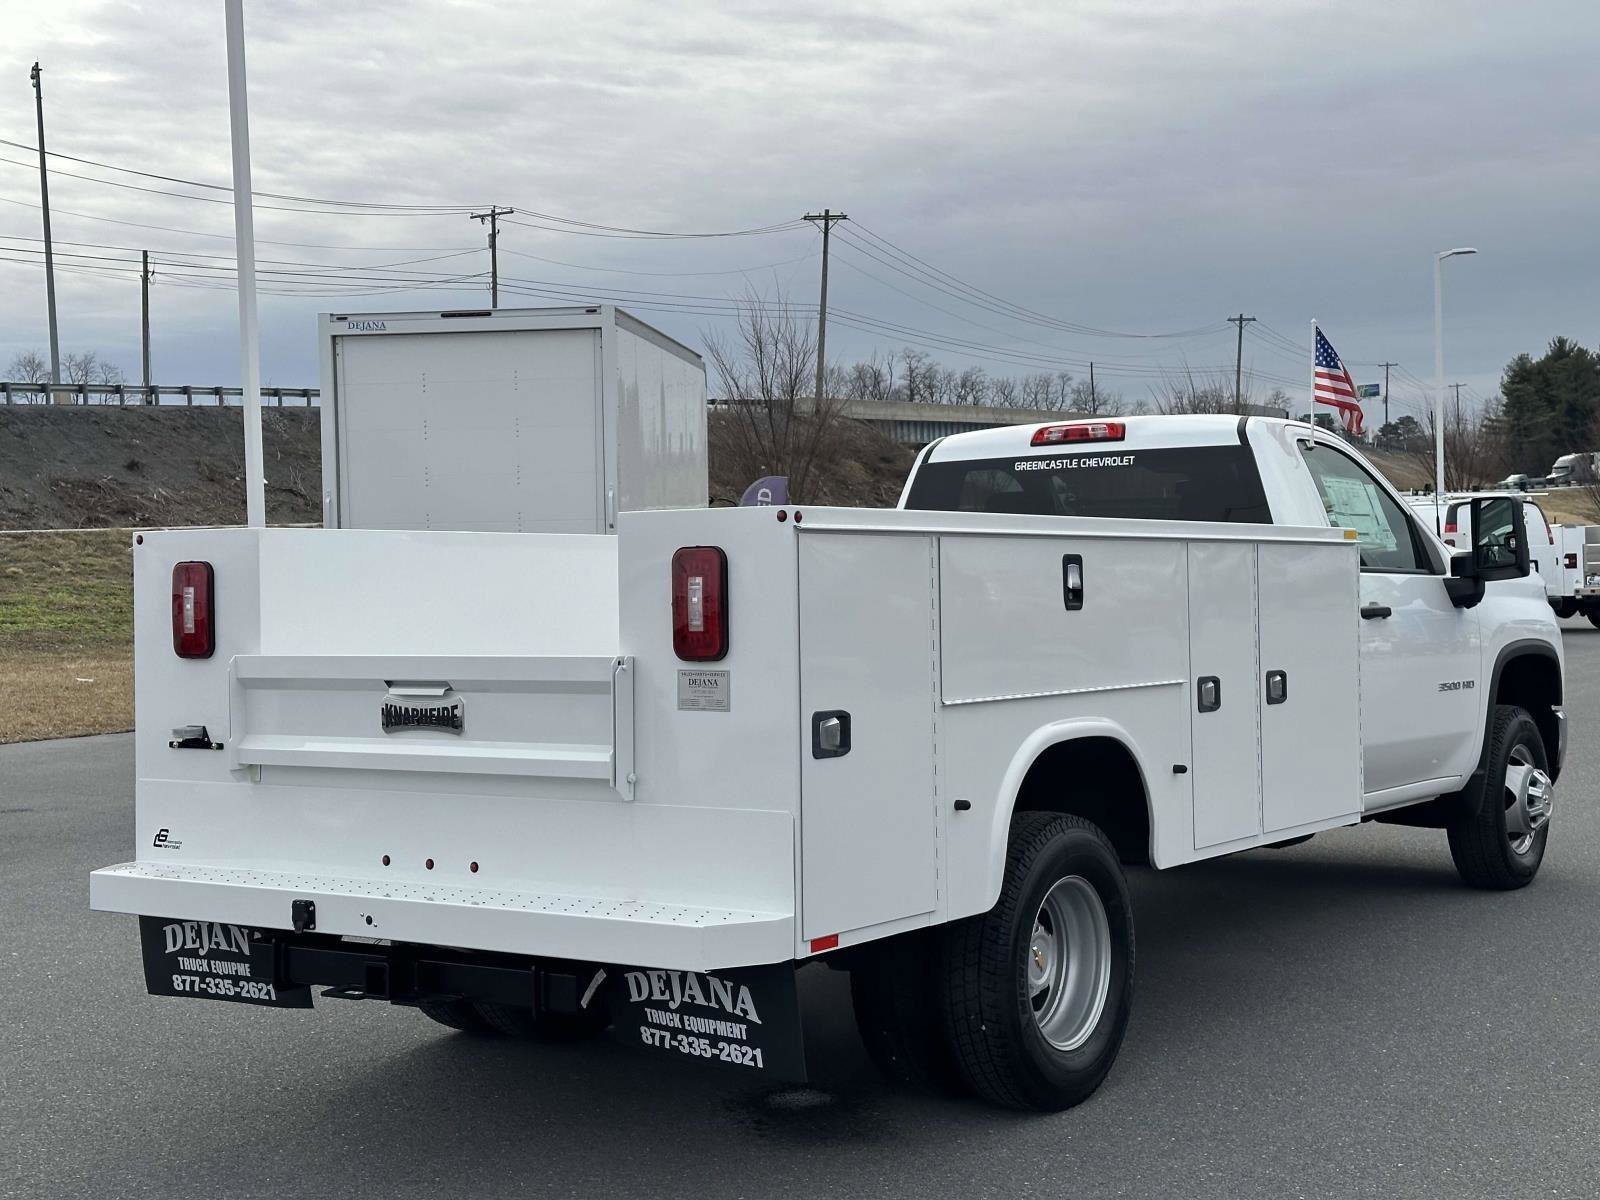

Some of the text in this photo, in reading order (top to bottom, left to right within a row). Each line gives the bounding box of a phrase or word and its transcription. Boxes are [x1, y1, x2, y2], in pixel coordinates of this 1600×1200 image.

[347, 320, 386, 331] DEJANA
[1014, 455, 1136, 471] GREENCASTLE CHEVROLET
[688, 678, 719, 687] DEJANA
[1438, 680, 1475, 692] 3500 HD
[382, 703, 461, 729] KNAPHEIDE
[162, 921, 251, 956] DEJAN
[177, 956, 252, 977] TRUCK EQUIPME
[172, 974, 277, 1001] 877-335-2621
[624, 970, 763, 1025] DEJANA
[644, 1007, 748, 1041] TRUCK EQUIPMENT
[639, 1025, 764, 1069] 877-335-2621
